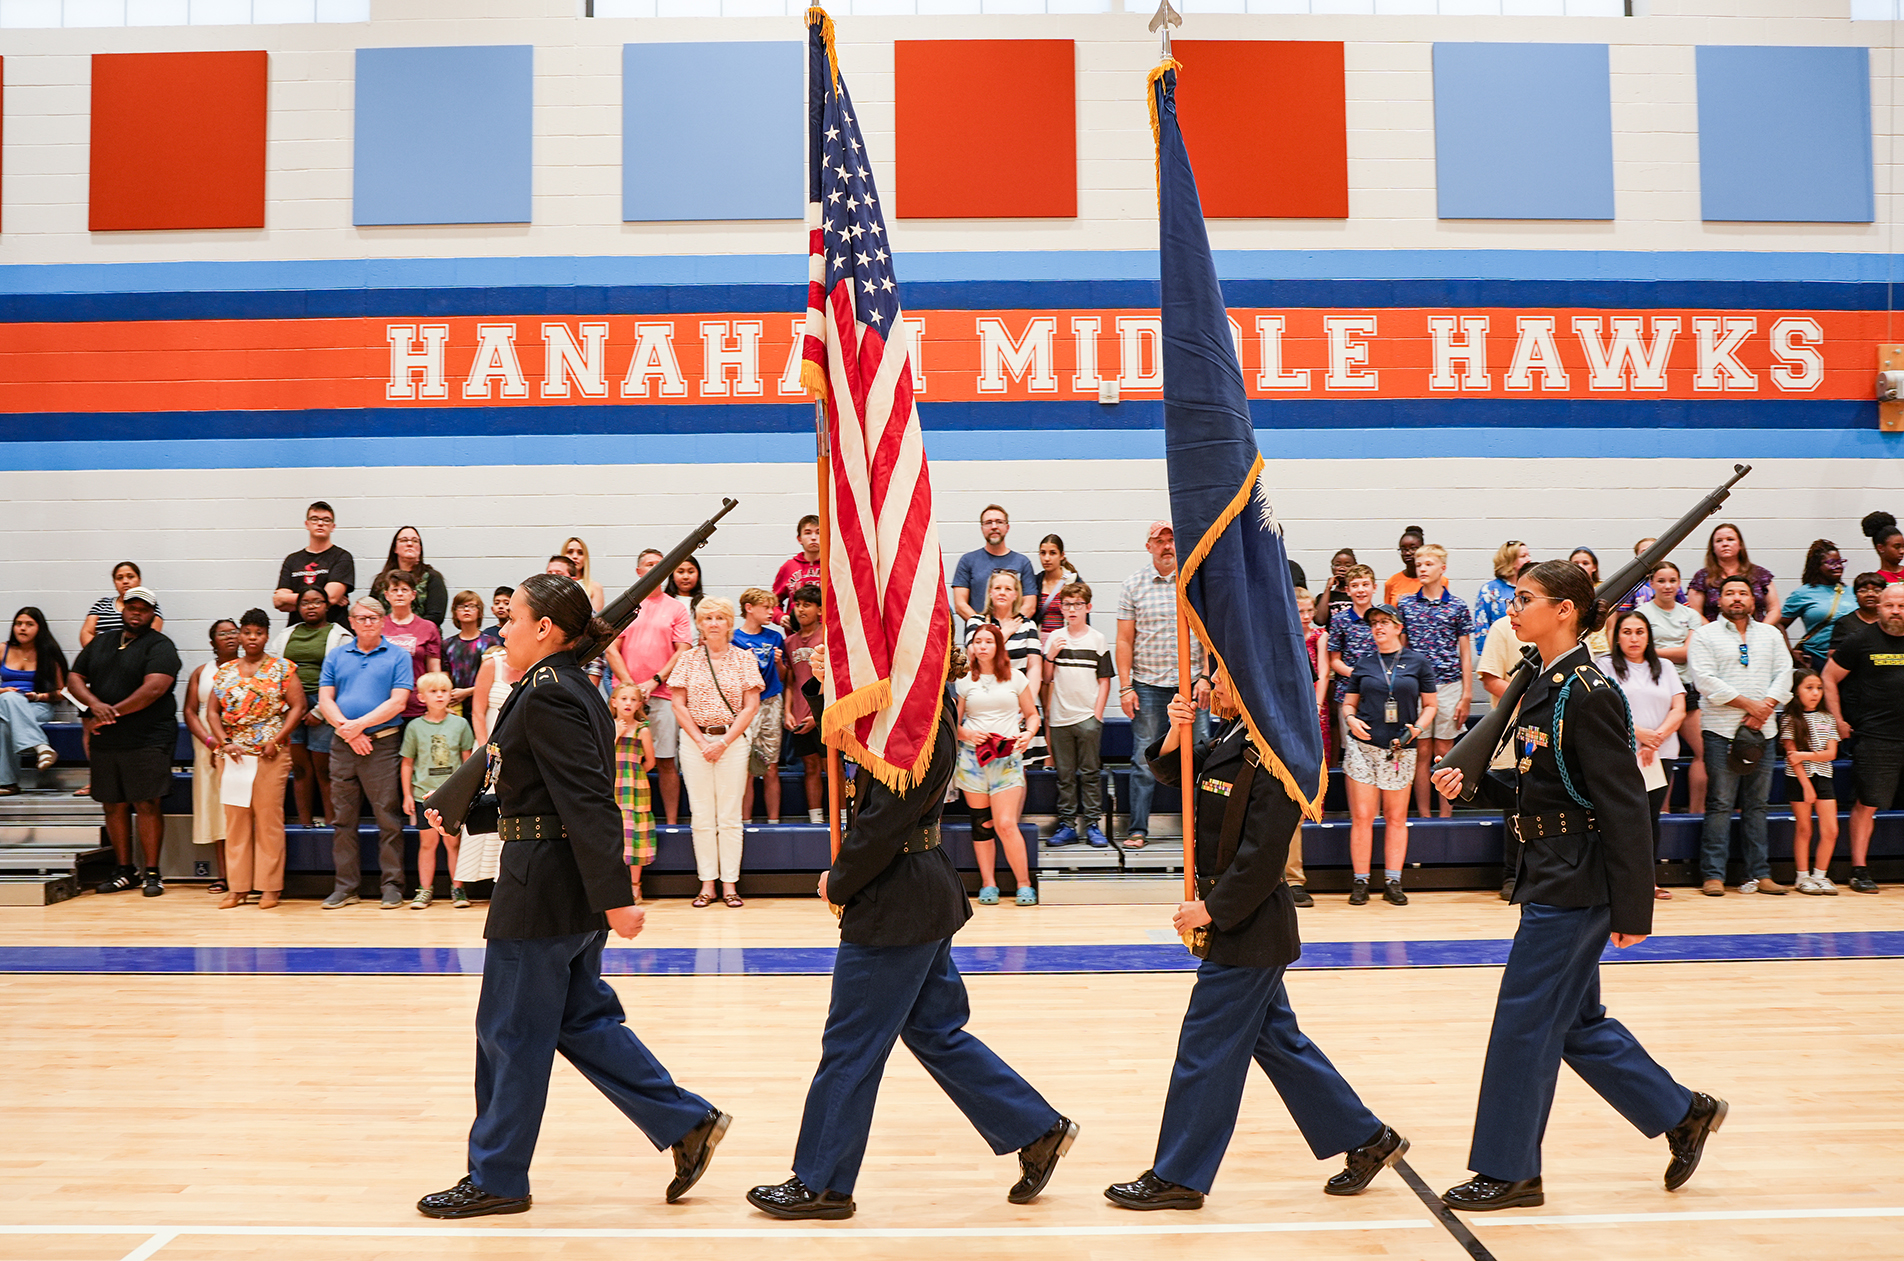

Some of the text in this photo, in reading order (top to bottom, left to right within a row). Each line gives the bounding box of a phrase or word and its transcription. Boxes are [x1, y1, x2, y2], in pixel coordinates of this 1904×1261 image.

[386, 316, 1825, 400] HANAH MIDLE HAWKS
